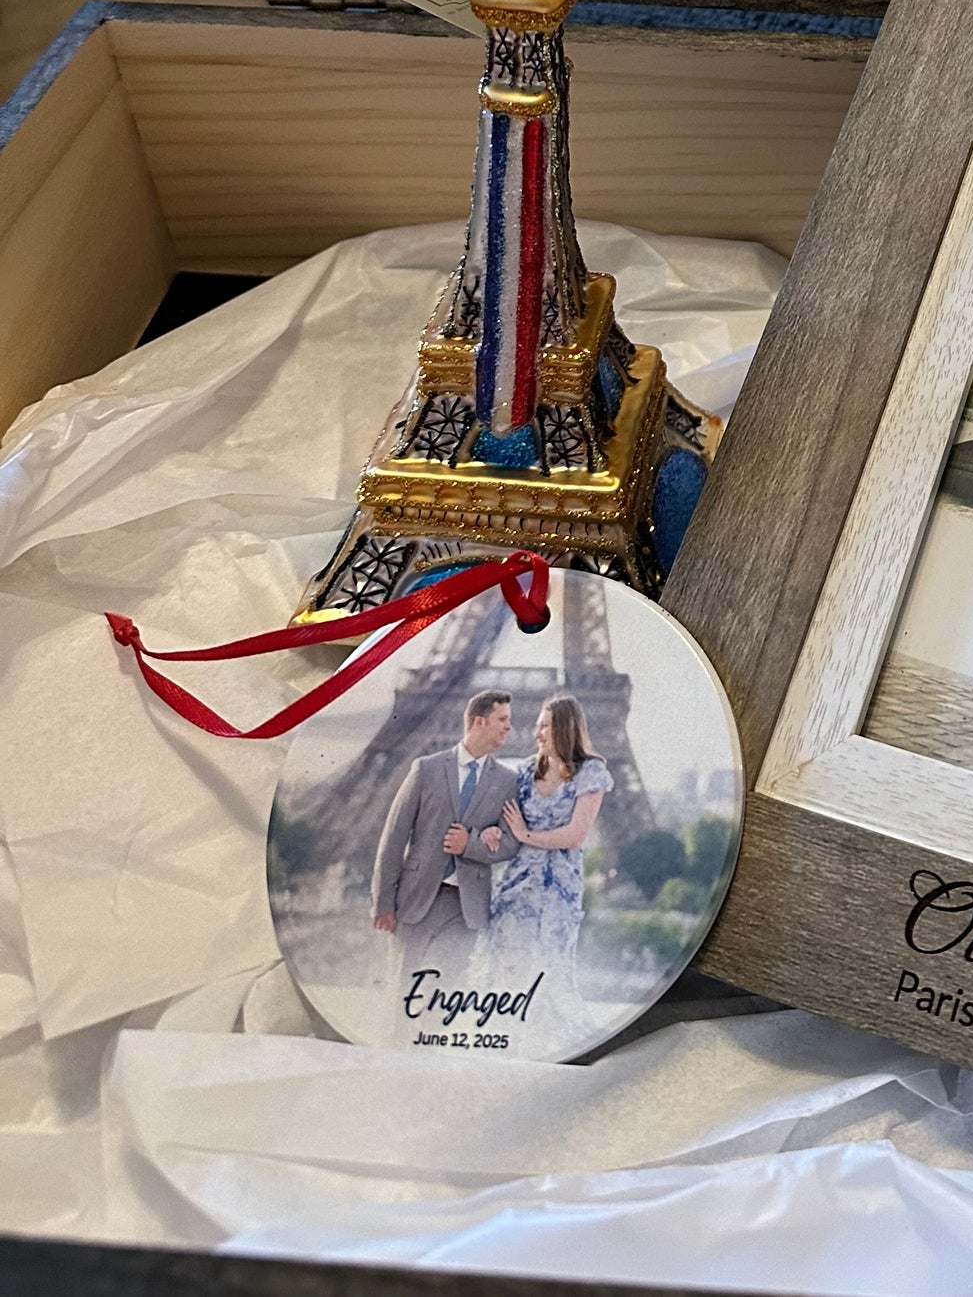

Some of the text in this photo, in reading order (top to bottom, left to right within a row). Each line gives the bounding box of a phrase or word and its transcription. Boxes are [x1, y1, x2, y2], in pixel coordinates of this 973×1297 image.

[403, 968, 545, 1028] Engaged
[413, 1030, 509, 1049] June 12, 2025
